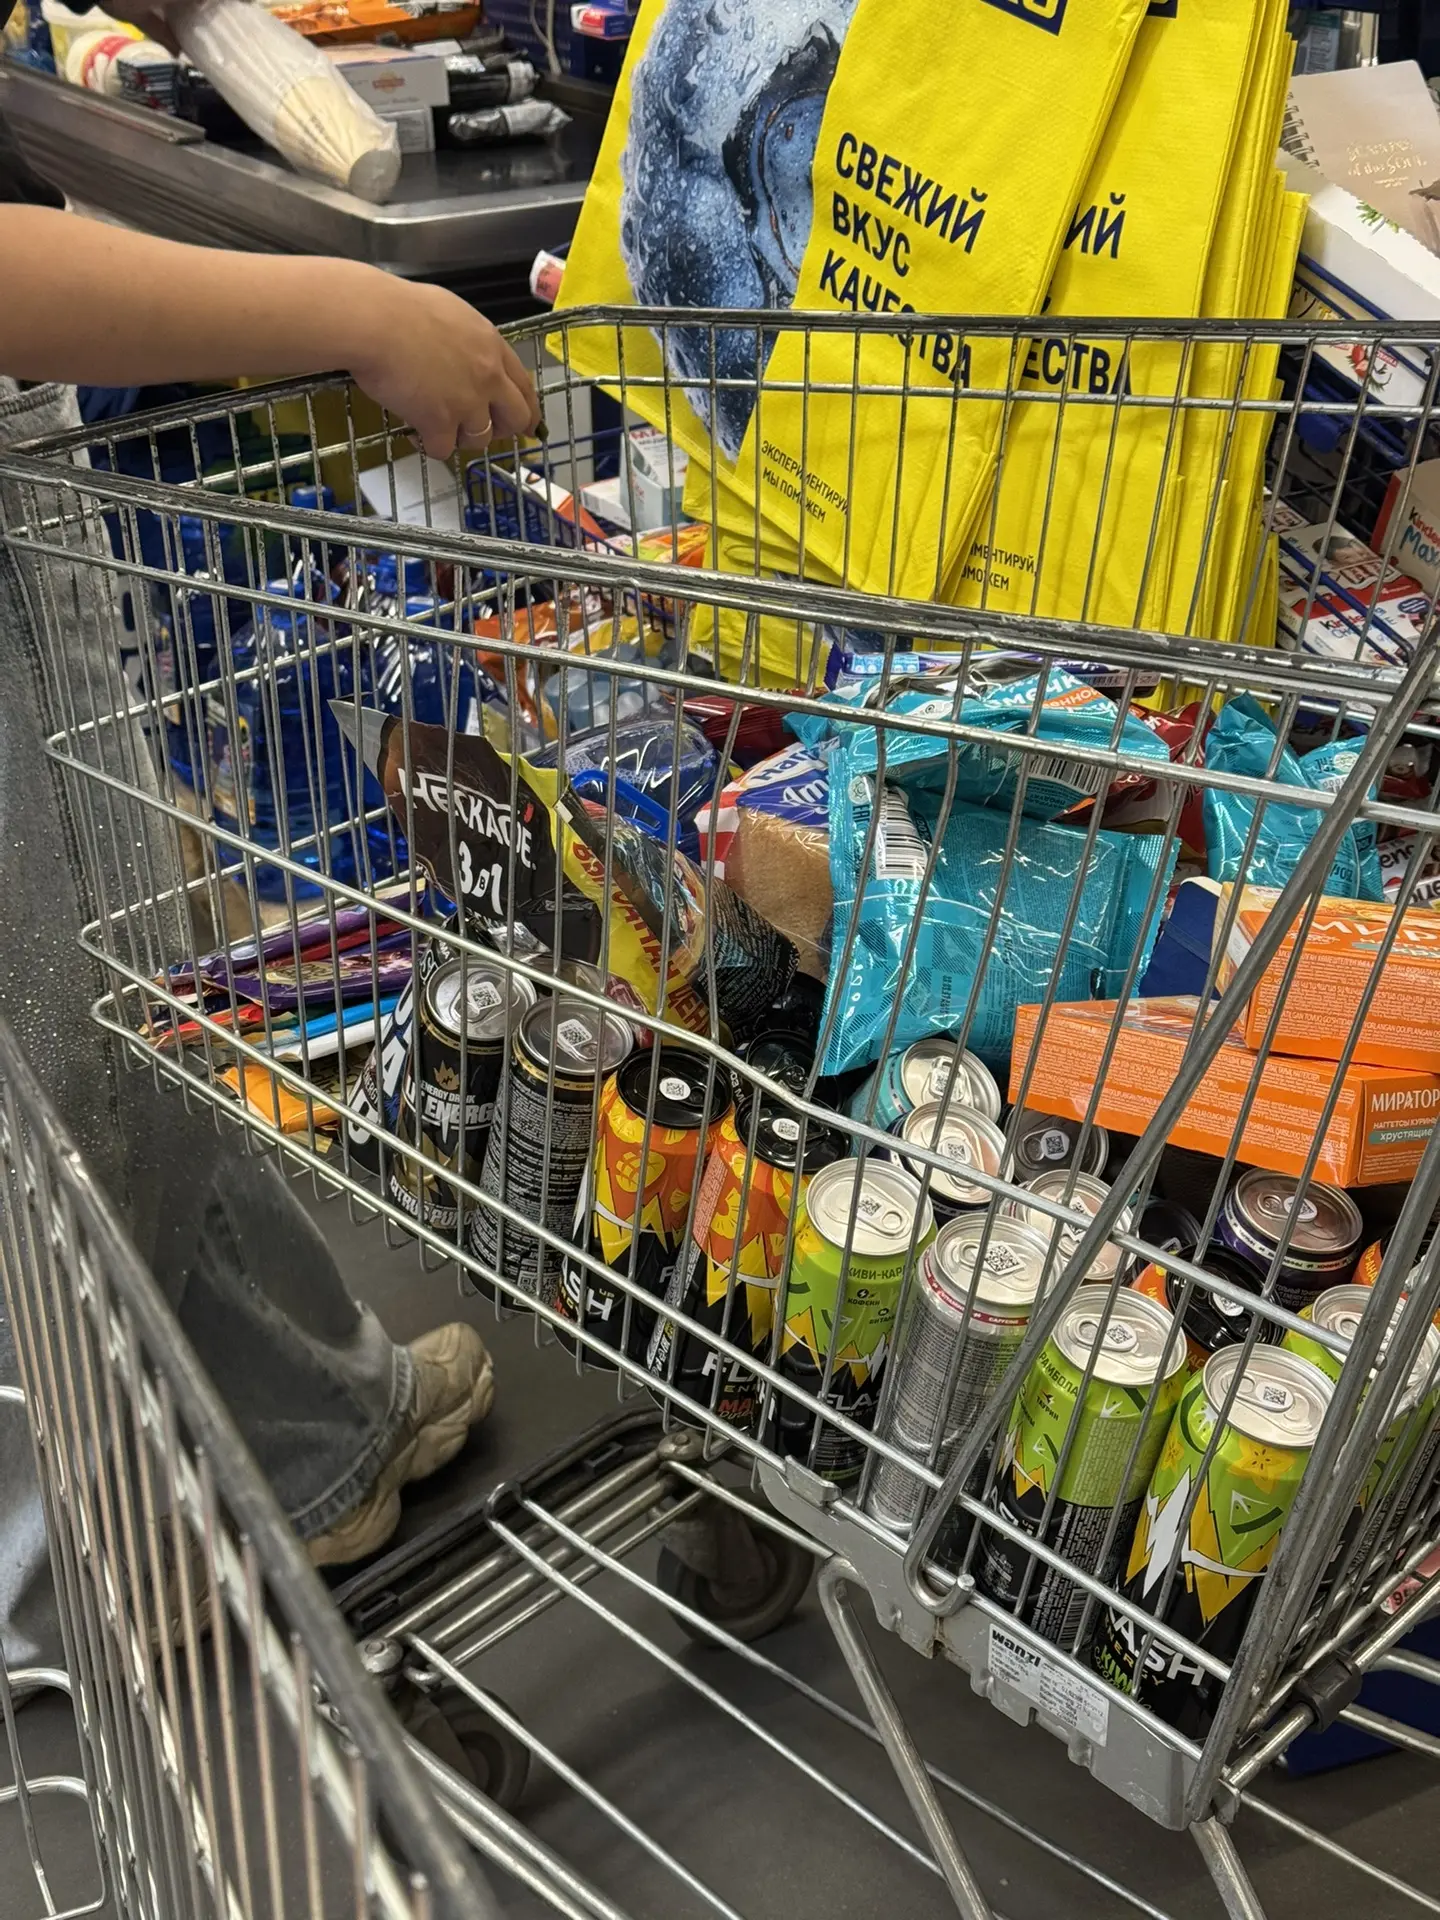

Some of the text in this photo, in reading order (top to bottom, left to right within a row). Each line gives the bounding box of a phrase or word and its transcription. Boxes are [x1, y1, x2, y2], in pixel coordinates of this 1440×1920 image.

[836, 131, 988, 254] СВЕЖИЙ
[832, 191, 911, 278] ВКУС
[1064, 191, 1126, 260] ИЙ
[1022, 338, 1131, 394] ЕСТВА
[762, 467, 826, 524] МЫ ПОМЖЕМ
[1380, 1128, 1434, 1143] хрустящие
[1036, 1350, 1079, 1398] РАМБОЛА
